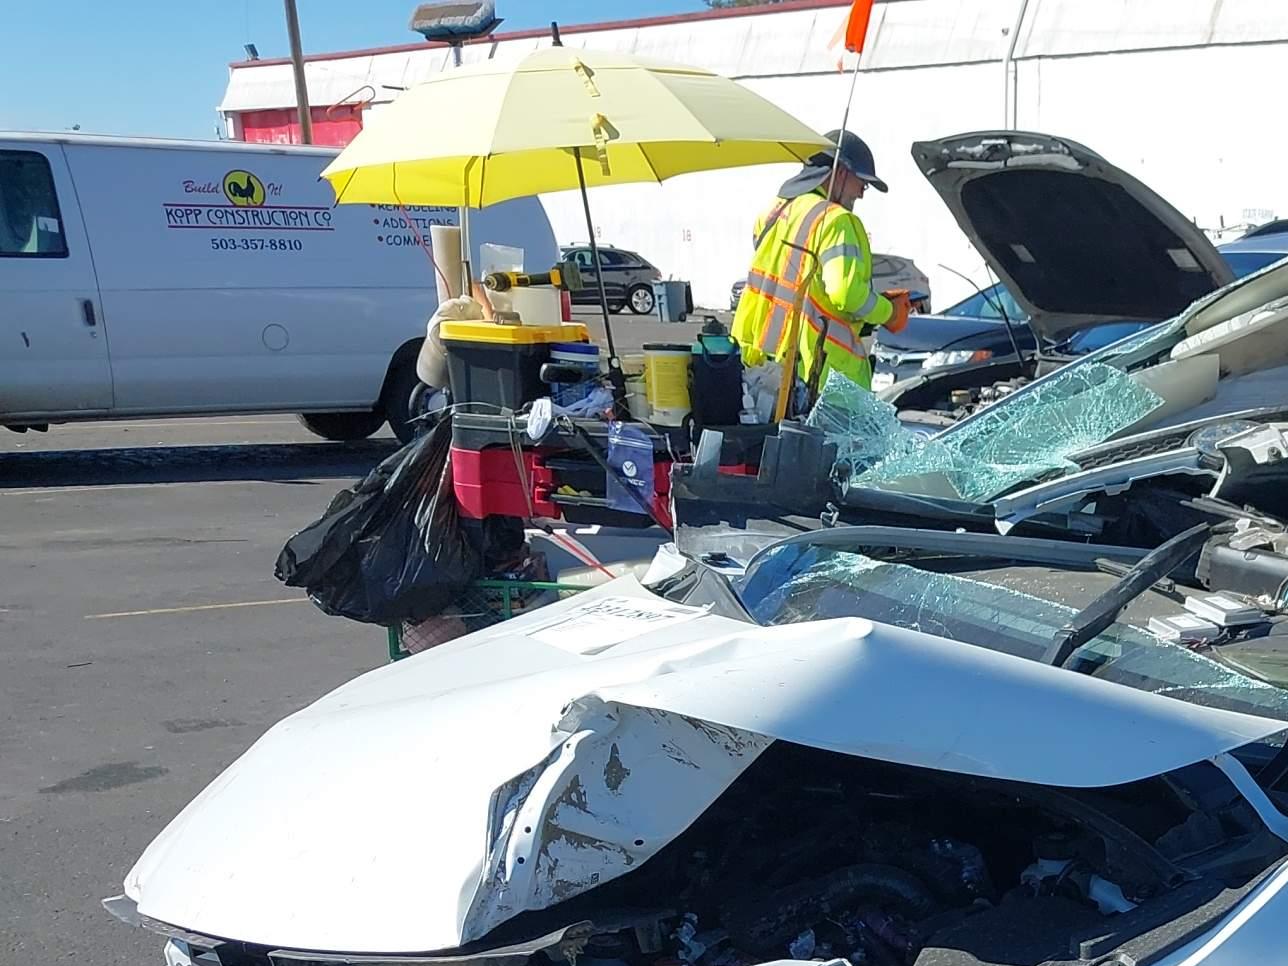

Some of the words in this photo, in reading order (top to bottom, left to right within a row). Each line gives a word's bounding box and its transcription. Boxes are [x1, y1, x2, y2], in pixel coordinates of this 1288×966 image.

[183, 179, 220, 194] Build
[165, 207, 202, 225] KOPP
[206, 208, 311, 227] CONSTRUCTION
[314, 211, 332, 228] CO
[211, 238, 303, 251] 503-357-8810
